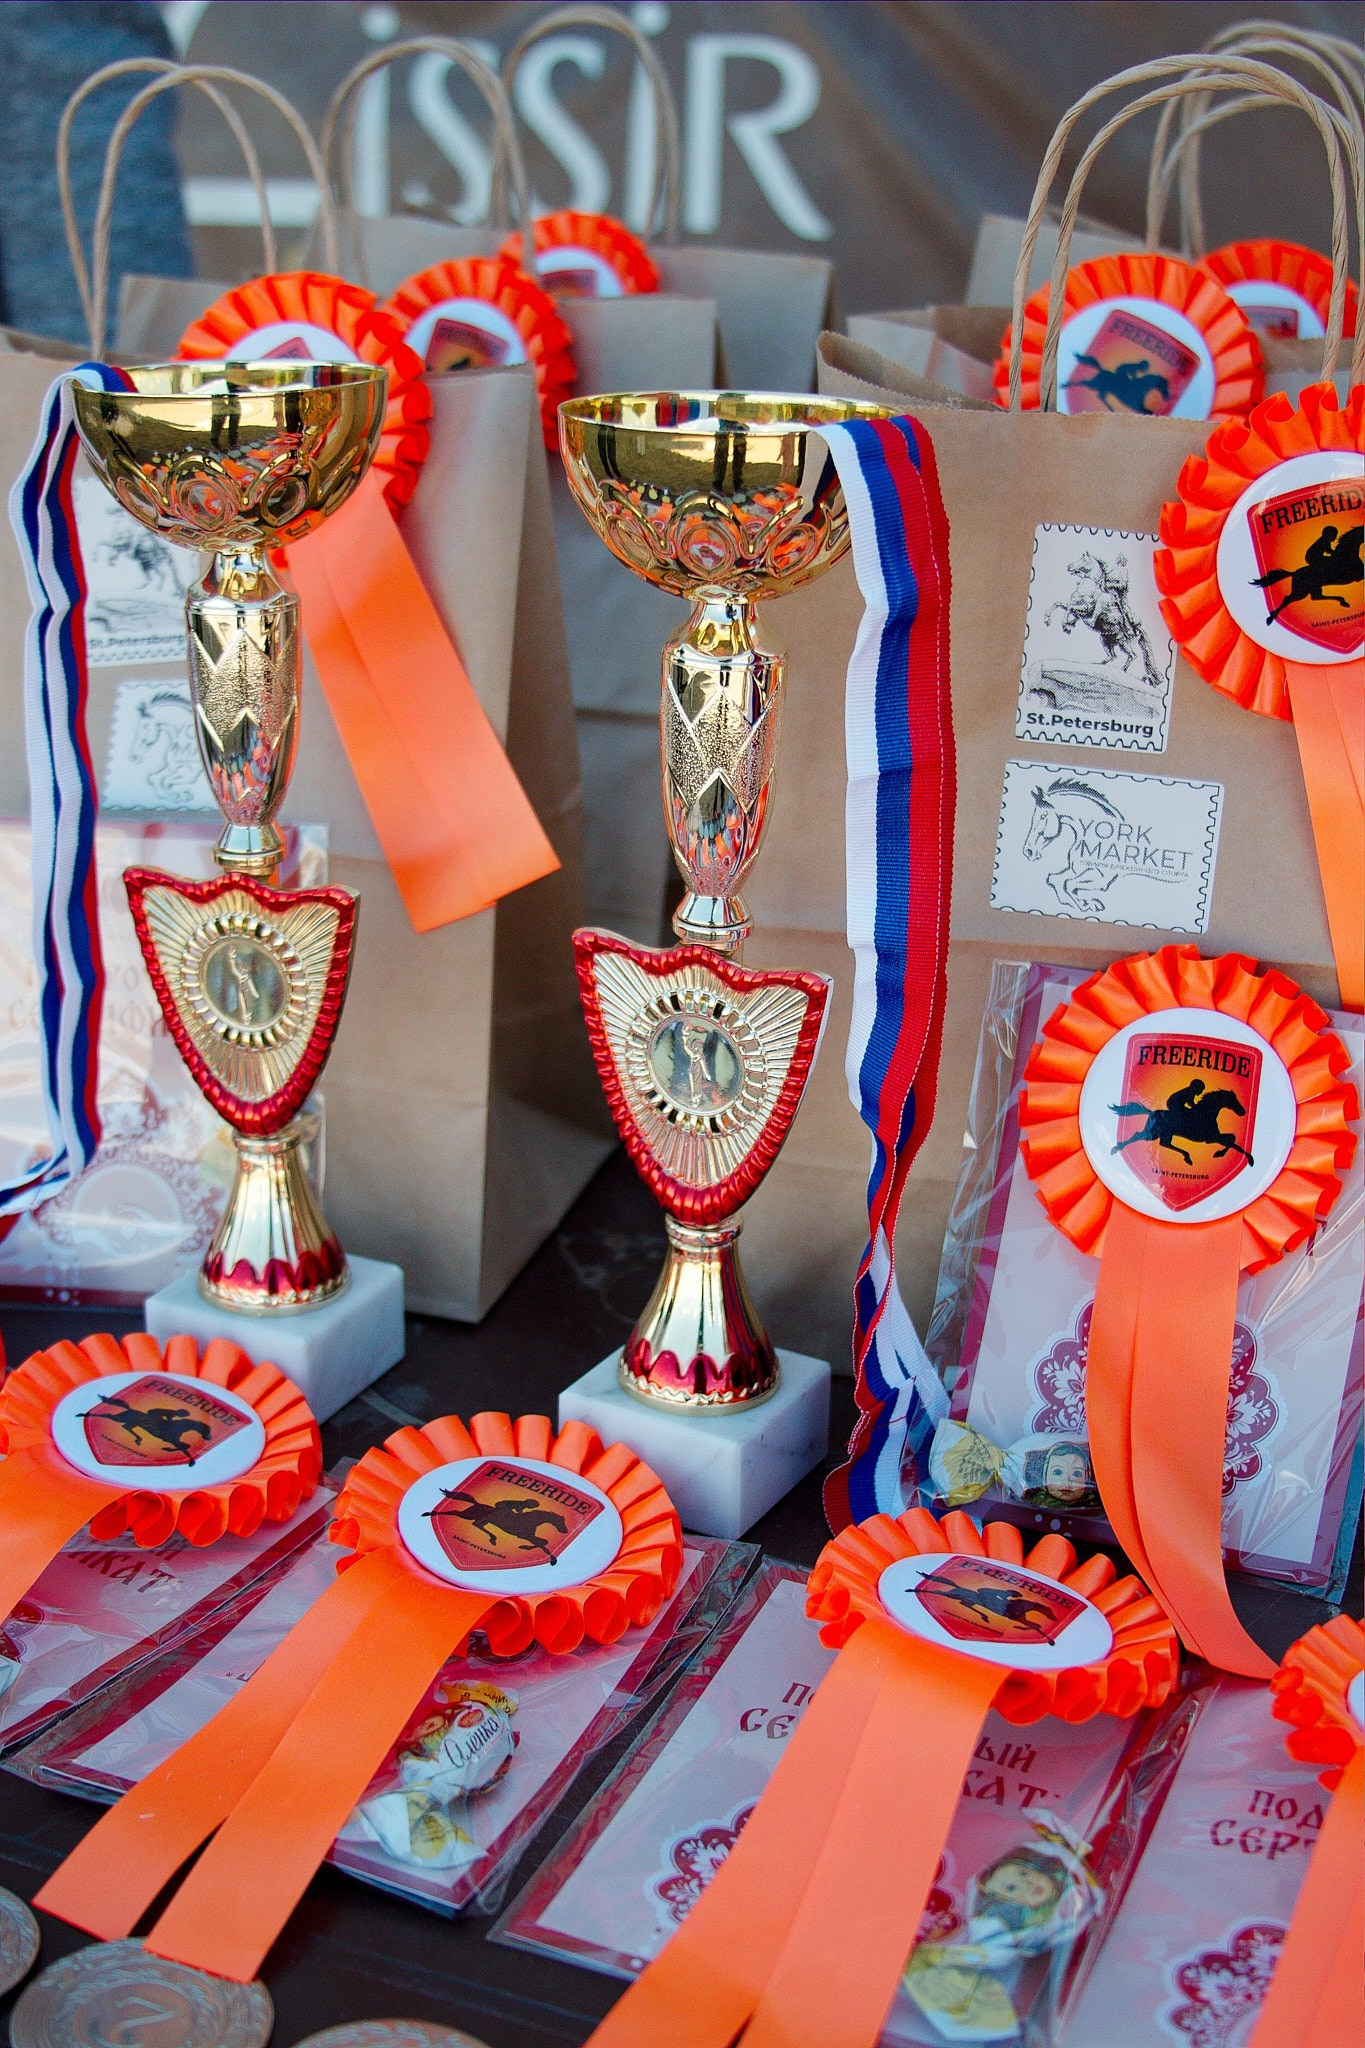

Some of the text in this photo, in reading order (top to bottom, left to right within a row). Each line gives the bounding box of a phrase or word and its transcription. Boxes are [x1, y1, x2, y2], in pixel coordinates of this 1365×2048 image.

[1260, 487, 1365, 535] FREERID
[1026, 712, 1154, 738] St.Petersburg
[1078, 818, 1152, 845] YORK
[1080, 839, 1193, 870] MARKET
[1137, 1045, 1252, 1079] FREERIDE
[145, 1380, 241, 1427] FREERIDE
[485, 1467, 593, 1515] FREERIDE
[960, 1560, 1076, 1610] FREERIDE
